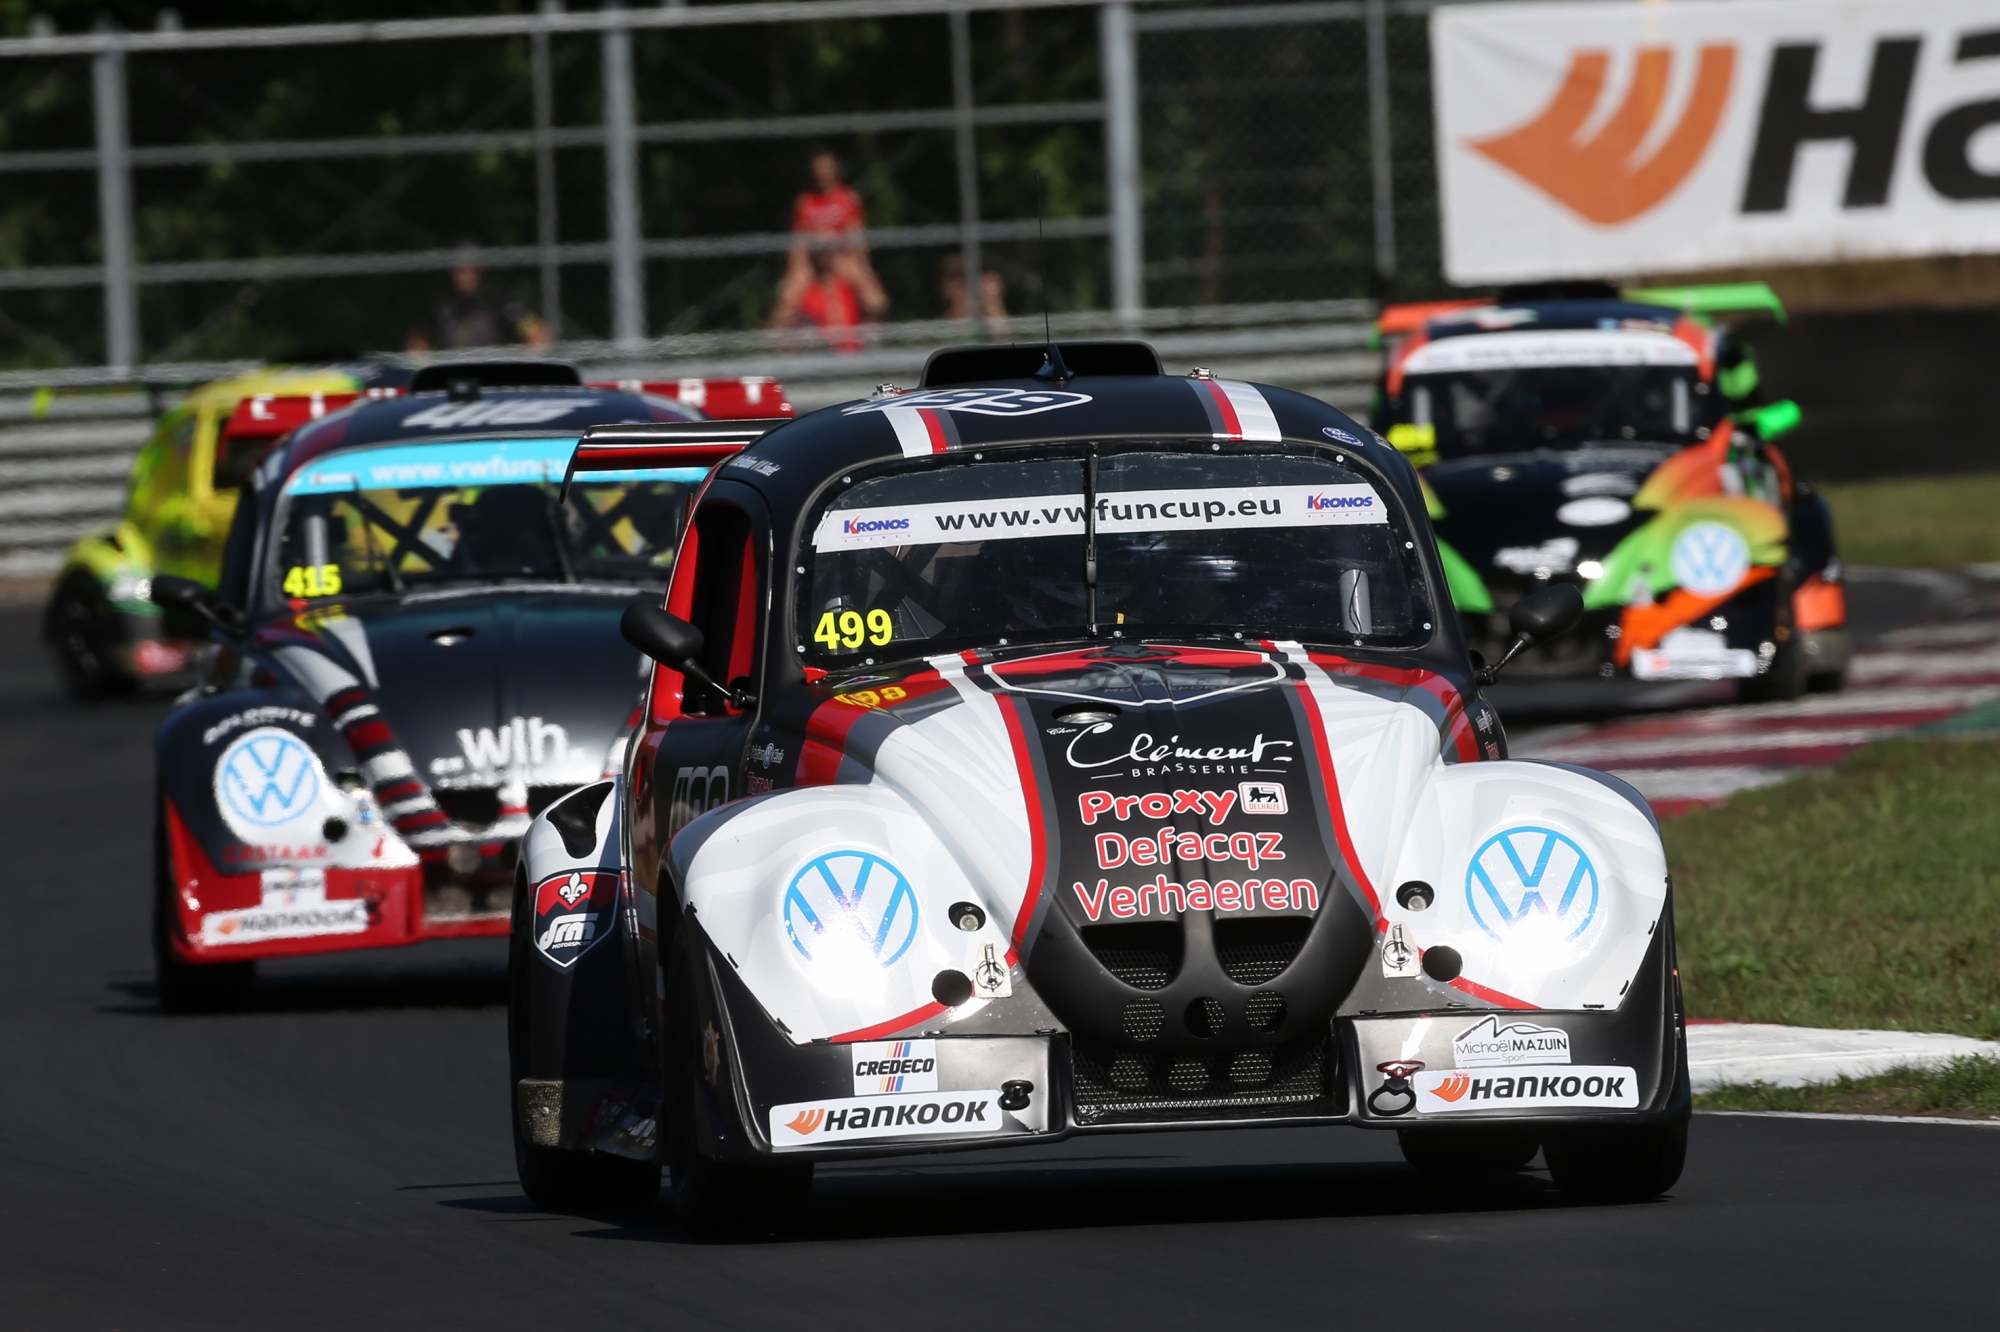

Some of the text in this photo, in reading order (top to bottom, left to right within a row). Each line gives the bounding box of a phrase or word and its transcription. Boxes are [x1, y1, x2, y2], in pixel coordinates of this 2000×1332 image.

[935, 498, 1282, 531] www.vwfuncup.eu
[1307, 491, 1373, 510] KRONOS
[844, 515, 910, 534] KRONOS
[283, 563, 342, 598] 415
[814, 608, 893, 651] 499
[1066, 722, 1294, 768] Clément
[1131, 763, 1249, 778] BRASSERIE
[1078, 789, 1282, 825] Proxy DELHAIZE
[1095, 827, 1286, 871] Defacqz
[1073, 874, 1319, 921] Verhaeren
[855, 1058, 935, 1077] CREDECO
[1501, 1053, 1526, 1064] Sport
